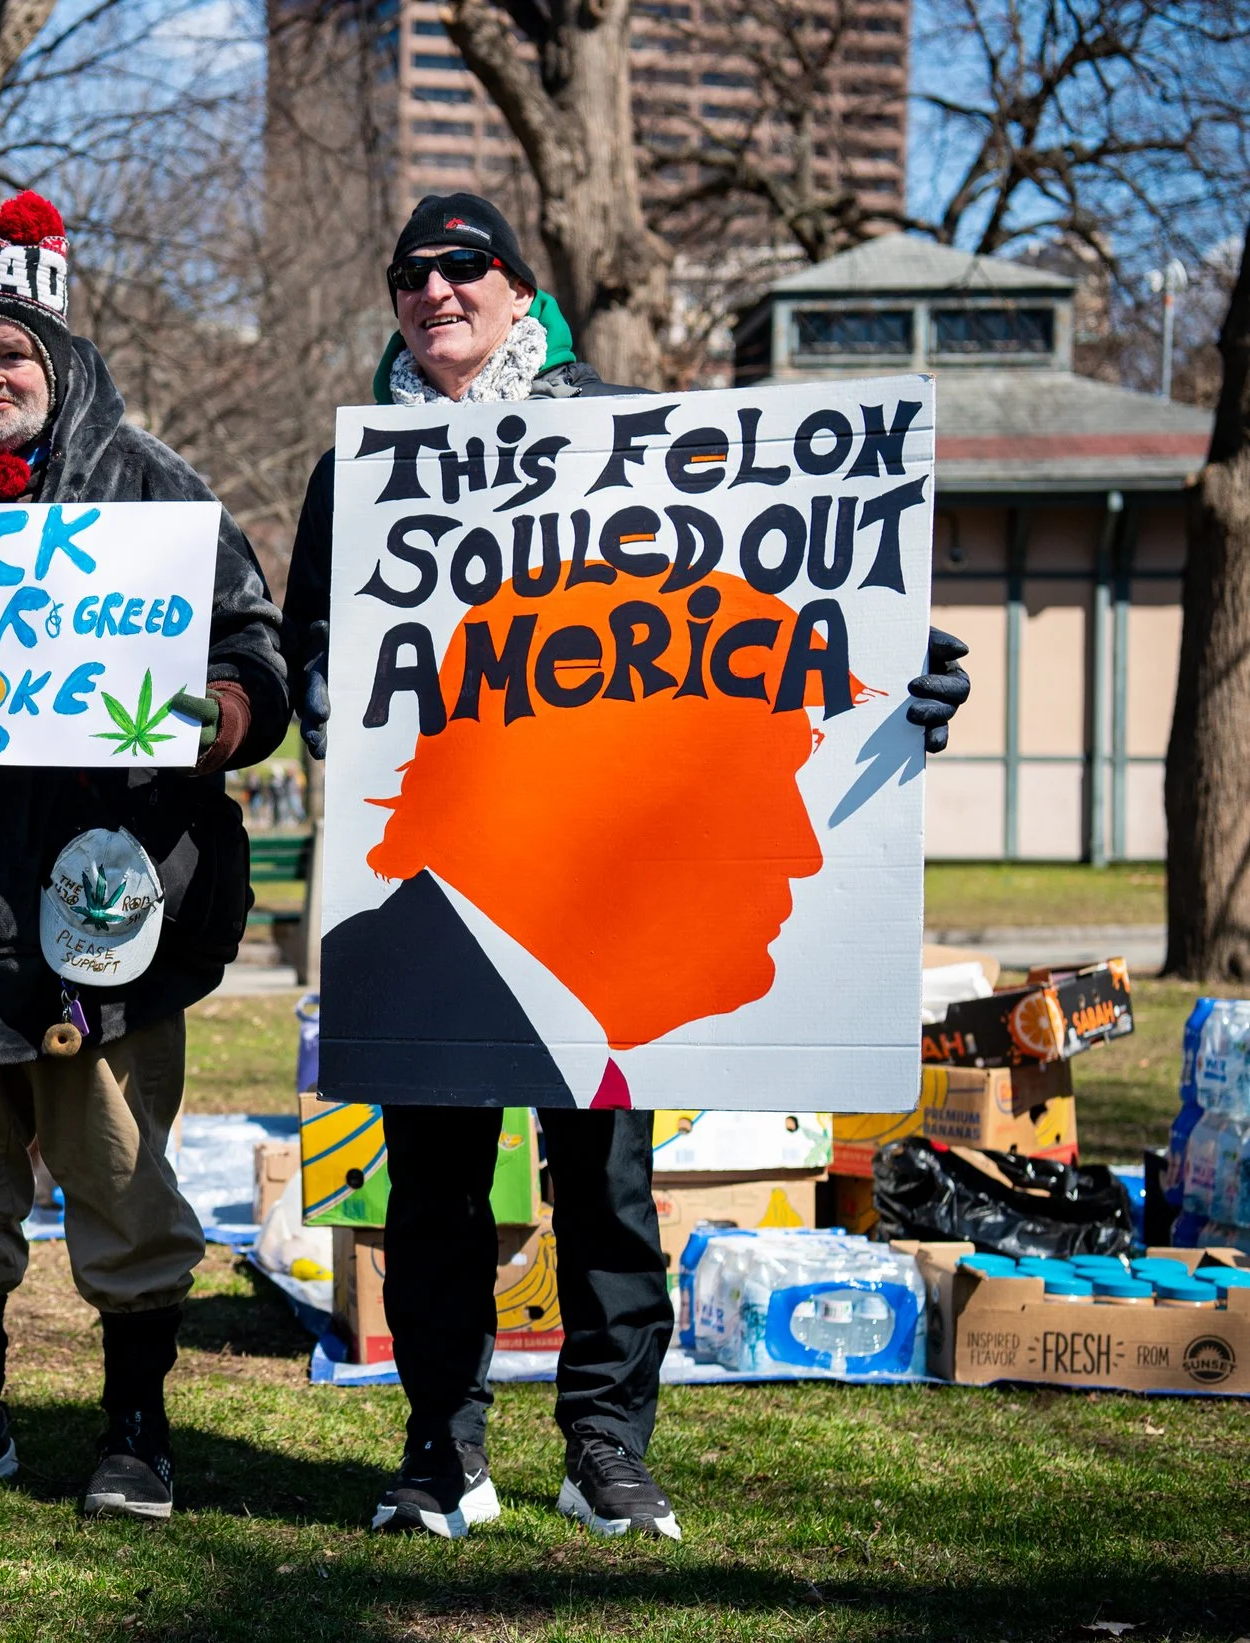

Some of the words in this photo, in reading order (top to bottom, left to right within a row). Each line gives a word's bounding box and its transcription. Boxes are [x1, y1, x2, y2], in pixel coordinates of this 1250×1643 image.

[739, 474, 930, 596] OUT
[72, 592, 194, 639] GREED
[60, 874, 83, 896] THE
[56, 928, 117, 961] PLEASE
[924, 1107, 981, 1124] PREMIUM
[923, 1123, 980, 1141] BANANAS
[967, 1332, 1020, 1350] INSPIRED
[970, 1350, 1016, 1366] FLAVOR
[1042, 1331, 1111, 1375] FRESH
[1136, 1346, 1170, 1367] FROM
[1182, 1358, 1237, 1374] SUNSET
